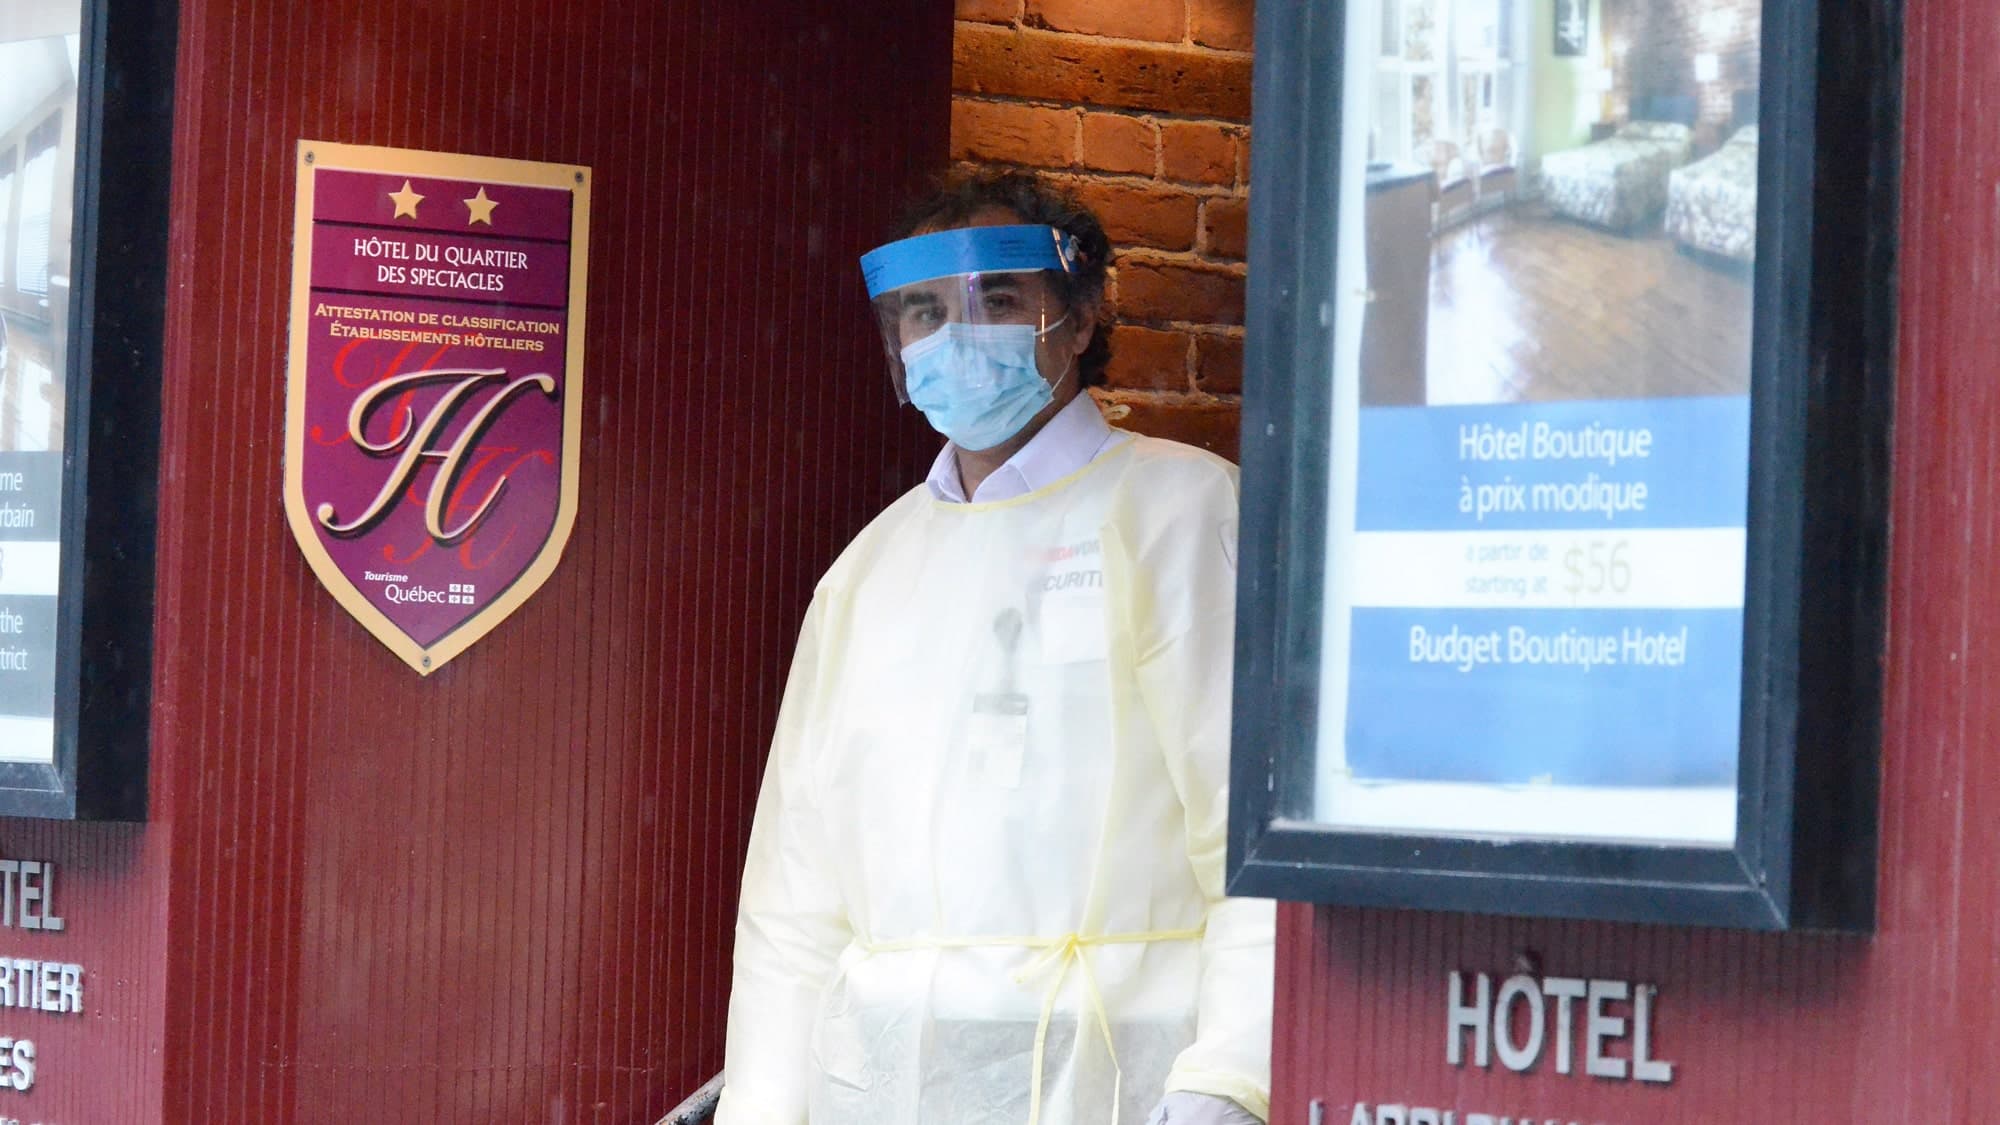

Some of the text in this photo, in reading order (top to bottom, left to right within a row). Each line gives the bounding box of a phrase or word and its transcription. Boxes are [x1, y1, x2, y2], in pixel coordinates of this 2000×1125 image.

[354, 236, 529, 270] HÔTEL DU QUARTIER
[377, 265, 504, 292] DES SPECTACLES
[314, 303, 560, 335] ATTESTATION DE CLASSIFICATION
[330, 319, 545, 352] ÉTABLISSEMENTS HÔTELIERS
[1458, 421, 1653, 466] Hôtel Boutique
[1459, 471, 1649, 521] à prix modique
[363, 570, 446, 605] Tourisme Québec
[1042, 569, 1103, 592] CURIT
[1562, 538, 1633, 607] $56
[1408, 624, 1688, 672] Budget Boutique Hotel
